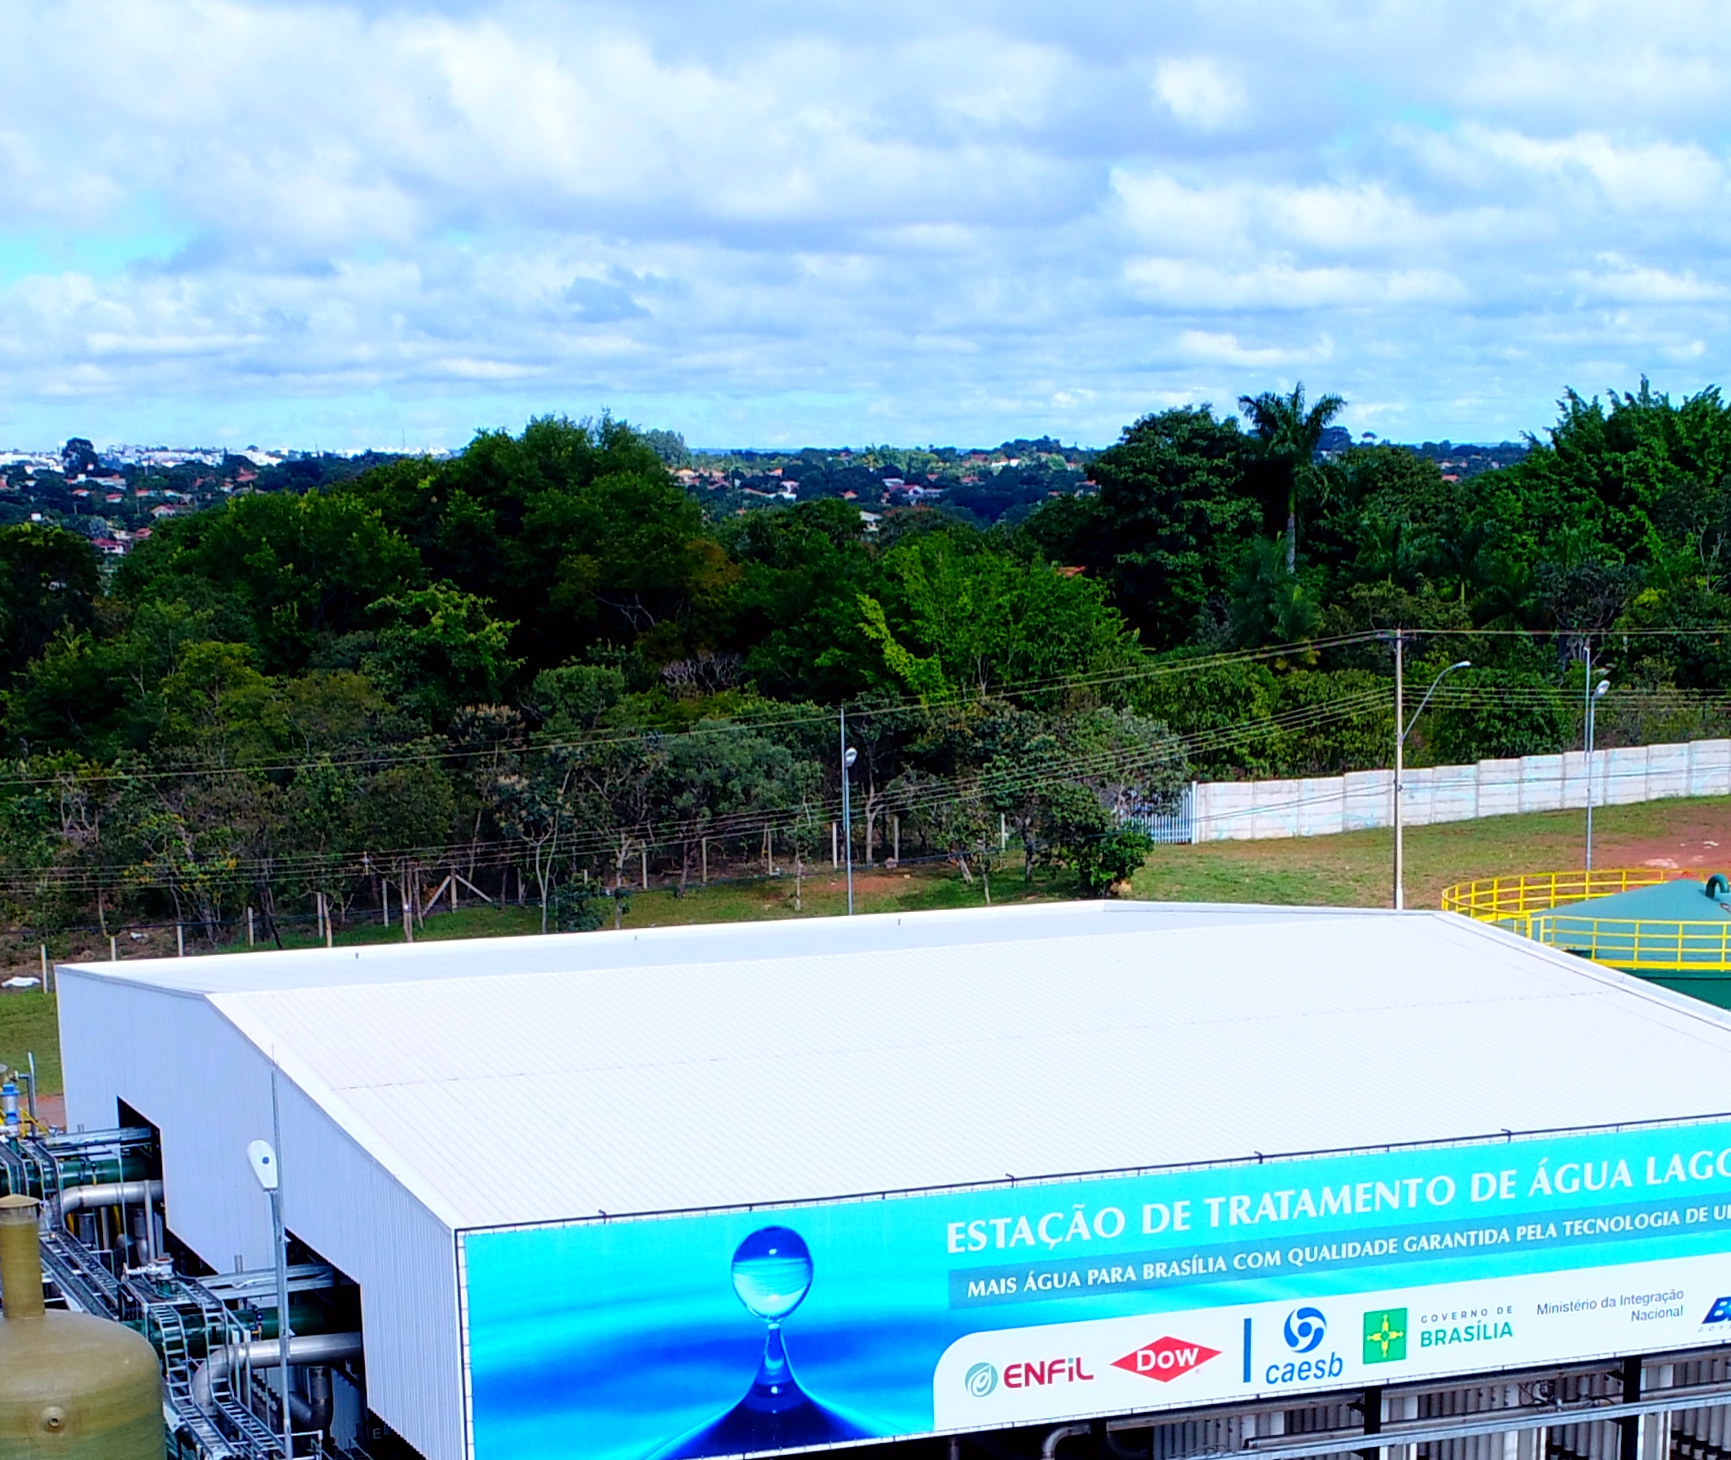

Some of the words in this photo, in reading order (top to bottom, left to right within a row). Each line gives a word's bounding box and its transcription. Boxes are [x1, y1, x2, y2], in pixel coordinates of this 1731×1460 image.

[947, 1203, 1126, 1253] ESTAÇÃO
[1142, 1200, 1191, 1235] DE
[1204, 1175, 1456, 1229] TRATAMENTO
[1470, 1169, 1517, 1203] DE
[1528, 1157, 1633, 1198] ÁGUA
[967, 1277, 1018, 1298] MAIS
[1023, 1270, 1082, 1292] ÁGUA
[1087, 1265, 1137, 1285] PARA
[1143, 1254, 1227, 1280] BRASÍLIA
[1233, 1250, 1282, 1270] COM
[1288, 1238, 1398, 1267] QUALIDADE
[1403, 1226, 1511, 1252] GARANTIDA
[1516, 1222, 1558, 1242] PELA
[1562, 1208, 1680, 1237] TECNOLOGIA
[1685, 1206, 1709, 1224] DE
[1420, 1308, 1489, 1324] GOVERNO
[1496, 1305, 1513, 1316] DE
[1536, 1298, 1598, 1316] Ministério
[1600, 1296, 1617, 1309] da
[1620, 1289, 1685, 1306] Integração
[1631, 1305, 1684, 1322] Nacional
[1420, 1320, 1513, 1348] BRASÍLIA
[1265, 1351, 1344, 1385] caesb
